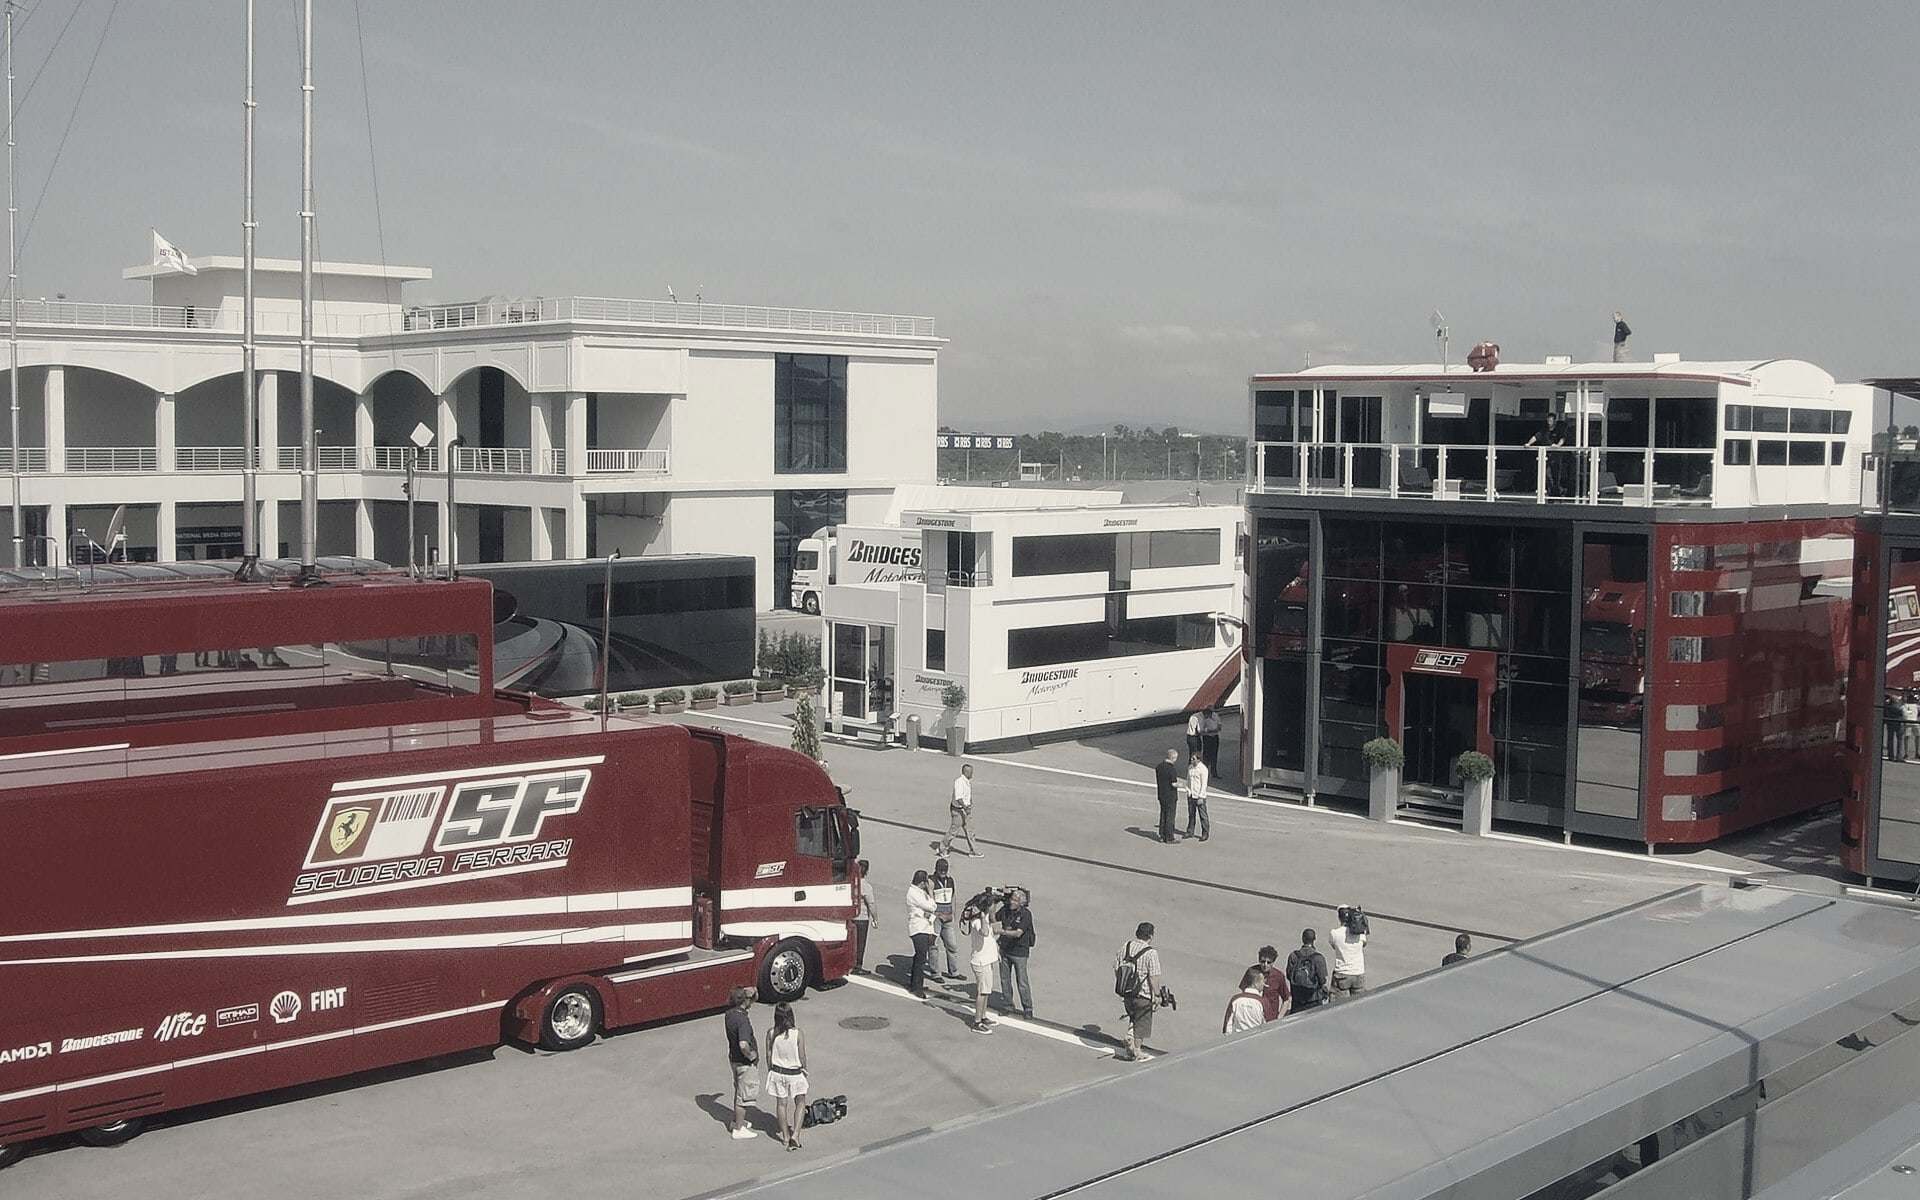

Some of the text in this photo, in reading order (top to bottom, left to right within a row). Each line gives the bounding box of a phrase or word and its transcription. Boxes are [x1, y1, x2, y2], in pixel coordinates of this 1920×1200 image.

[916, 517, 956, 527] BRIDGESTONE
[1103, 519, 1138, 527] BRIDGESTONE
[1436, 654, 1467, 667] SF
[1021, 668, 1079, 684] BRIDGESTONE
[434, 769, 592, 852] SF
[292, 839, 573, 894] SCUDERIA FERRARI
[311, 987, 347, 1012] FIAT
[218, 1008, 257, 1019] ETIHAD
[154, 1011, 206, 1042] Alice
[60, 1028, 144, 1053] BRIDGESTONE
[0, 1045, 37, 1064] AMD
